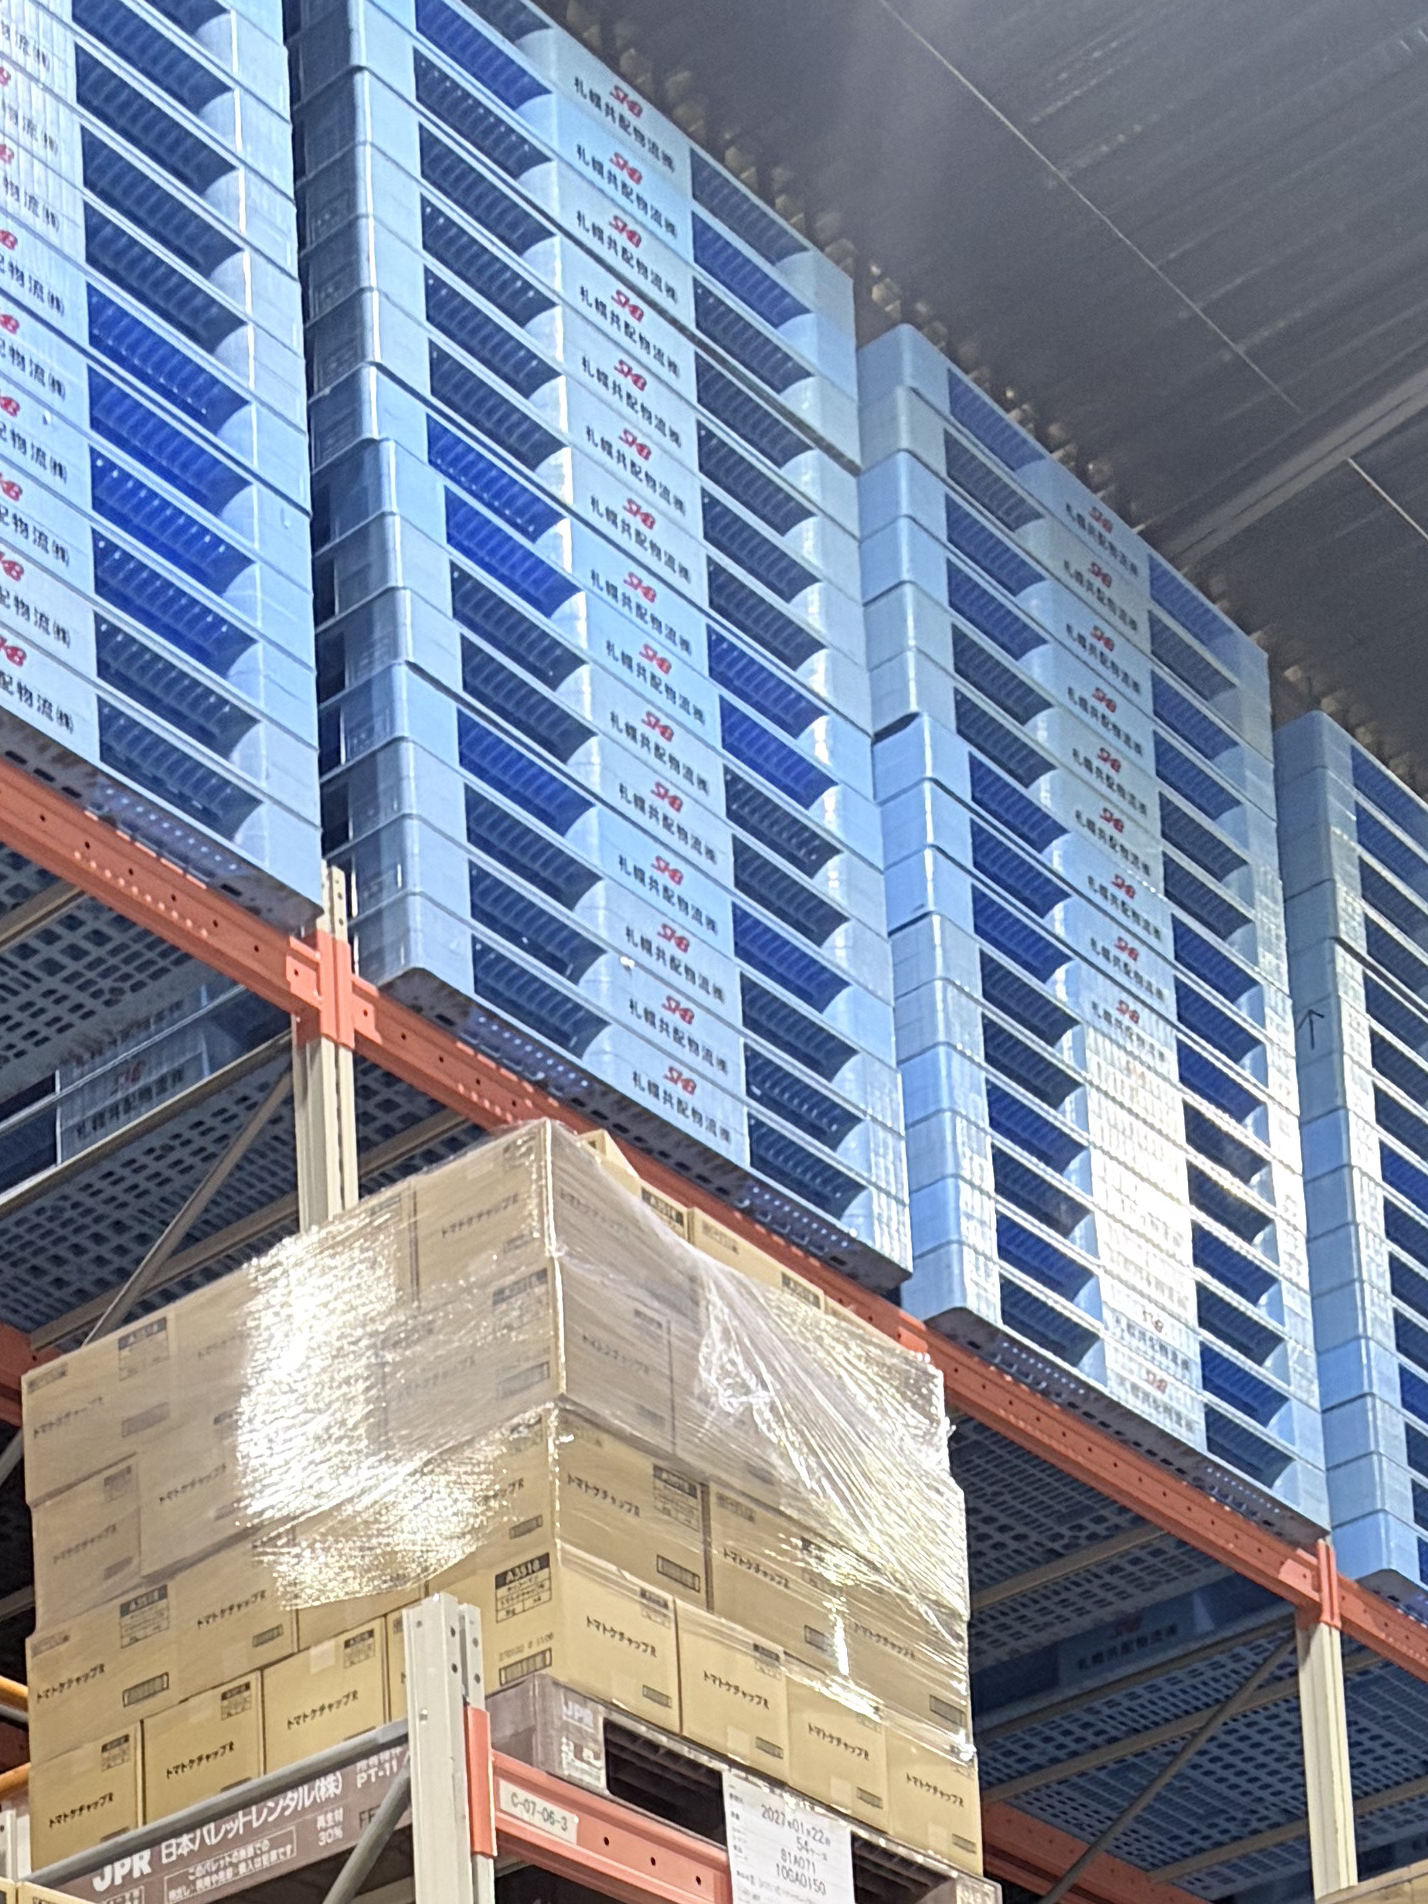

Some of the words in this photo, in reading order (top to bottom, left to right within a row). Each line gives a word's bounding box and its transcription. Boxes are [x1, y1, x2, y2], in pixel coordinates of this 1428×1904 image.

[92, 1852, 152, 1891] JPR
[161, 1771, 343, 1865] 日本パレットレンタル(株)
[318, 1828, 344, 1847] 30%
